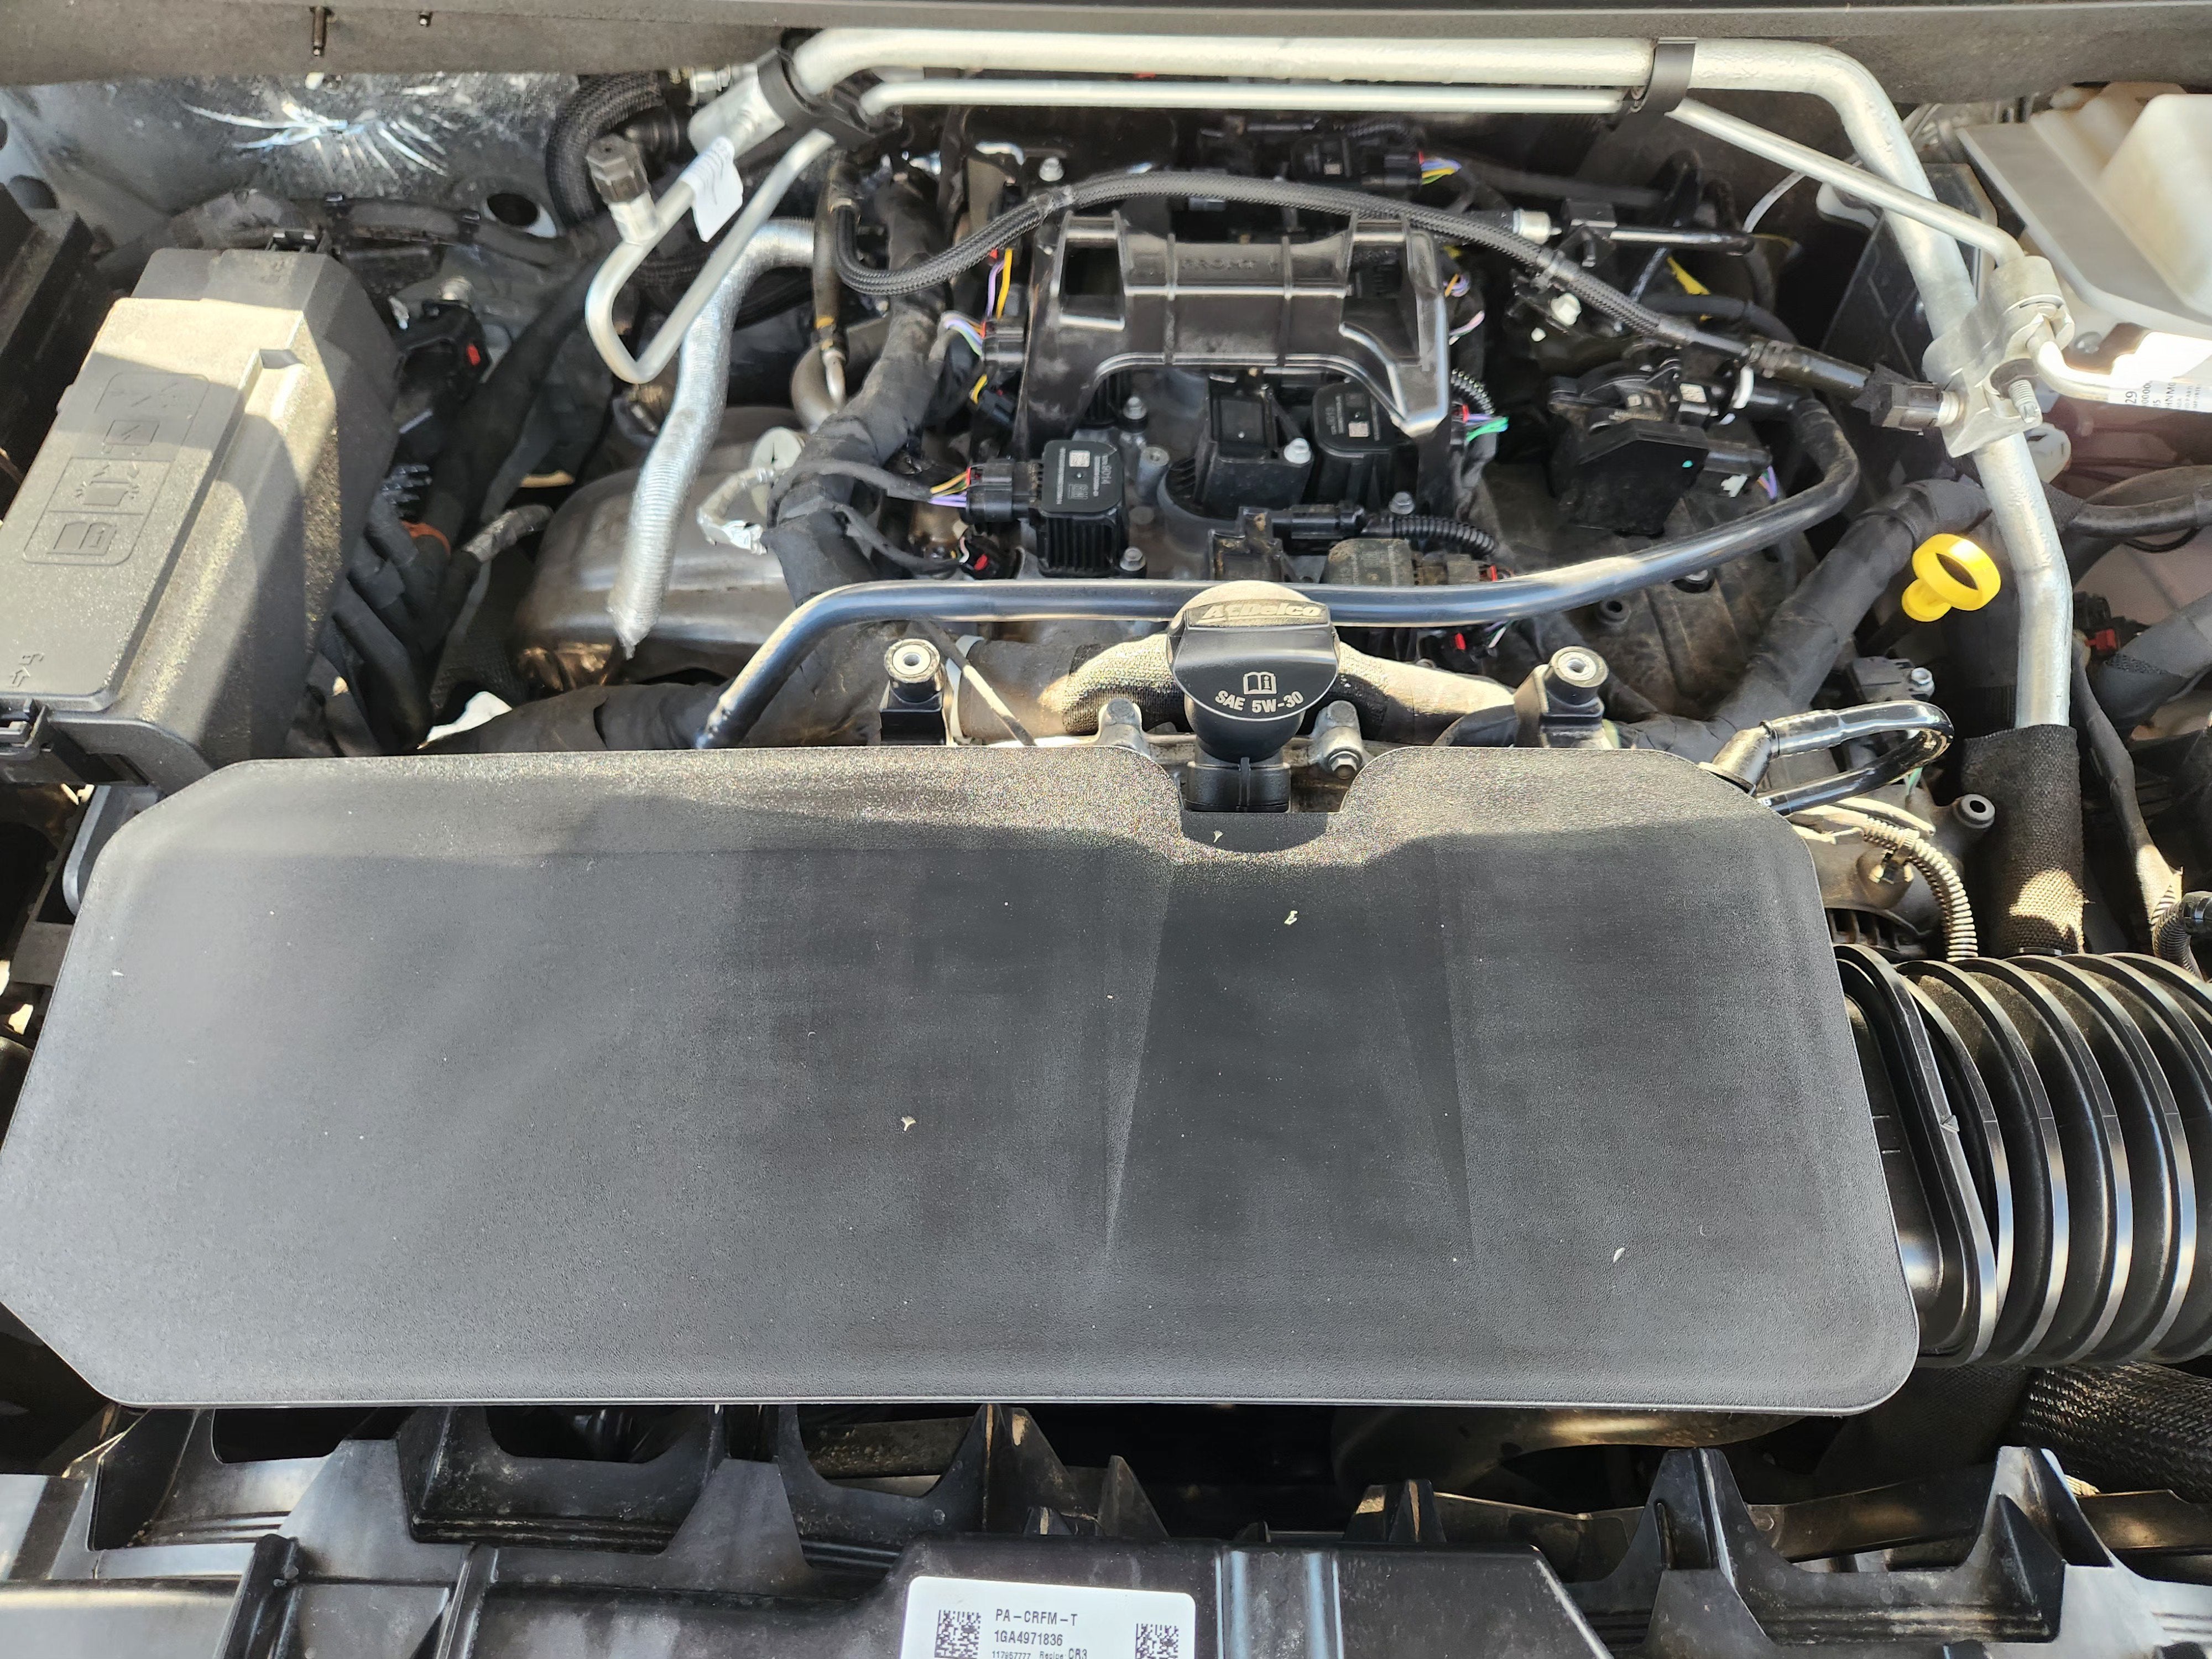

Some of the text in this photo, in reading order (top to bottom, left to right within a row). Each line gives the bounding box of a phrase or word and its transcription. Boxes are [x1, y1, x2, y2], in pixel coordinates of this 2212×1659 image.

[2125, 390, 2137, 404] 29
[1201, 603, 1323, 619] ACDelco
[1215, 690, 1304, 713] SAE 5W-30
[994, 1630, 1063, 1646] 1GA4971836
